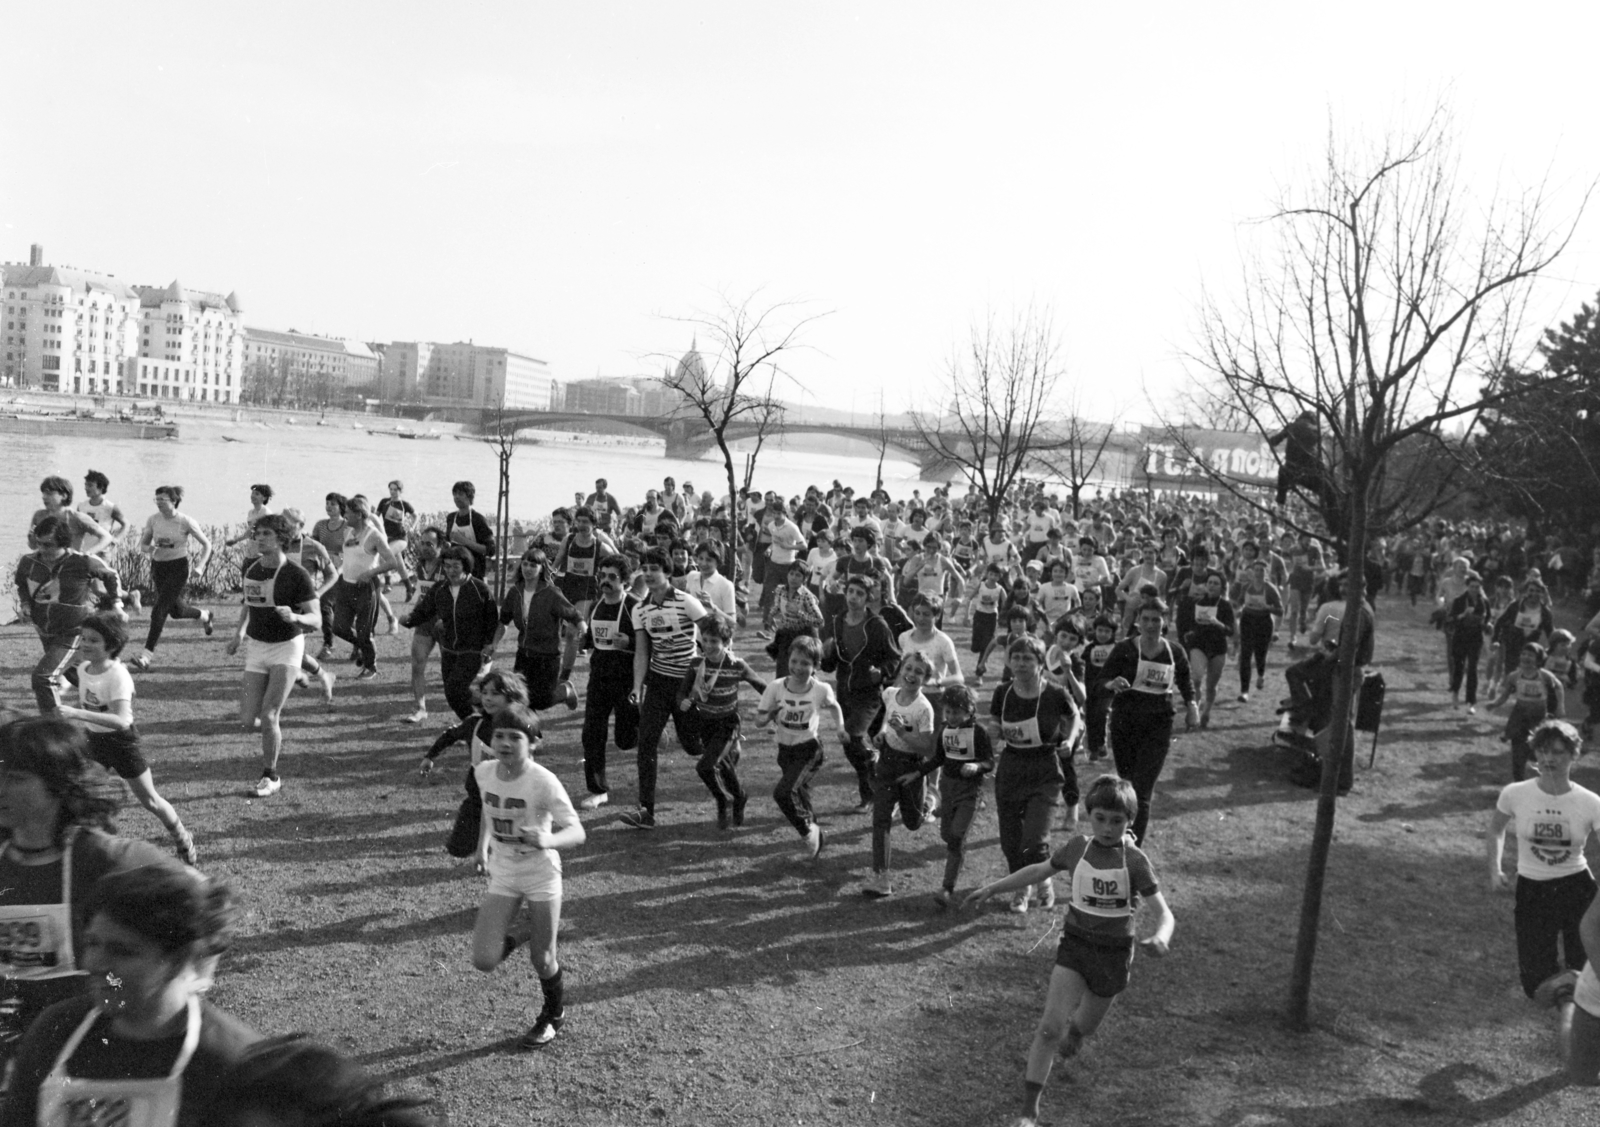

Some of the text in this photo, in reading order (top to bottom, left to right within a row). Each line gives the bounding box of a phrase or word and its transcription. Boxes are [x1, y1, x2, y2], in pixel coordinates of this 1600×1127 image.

[595, 627, 609, 638] 1927
[1534, 823, 1563, 838] 1258
[1092, 877, 1119, 896] 1912
